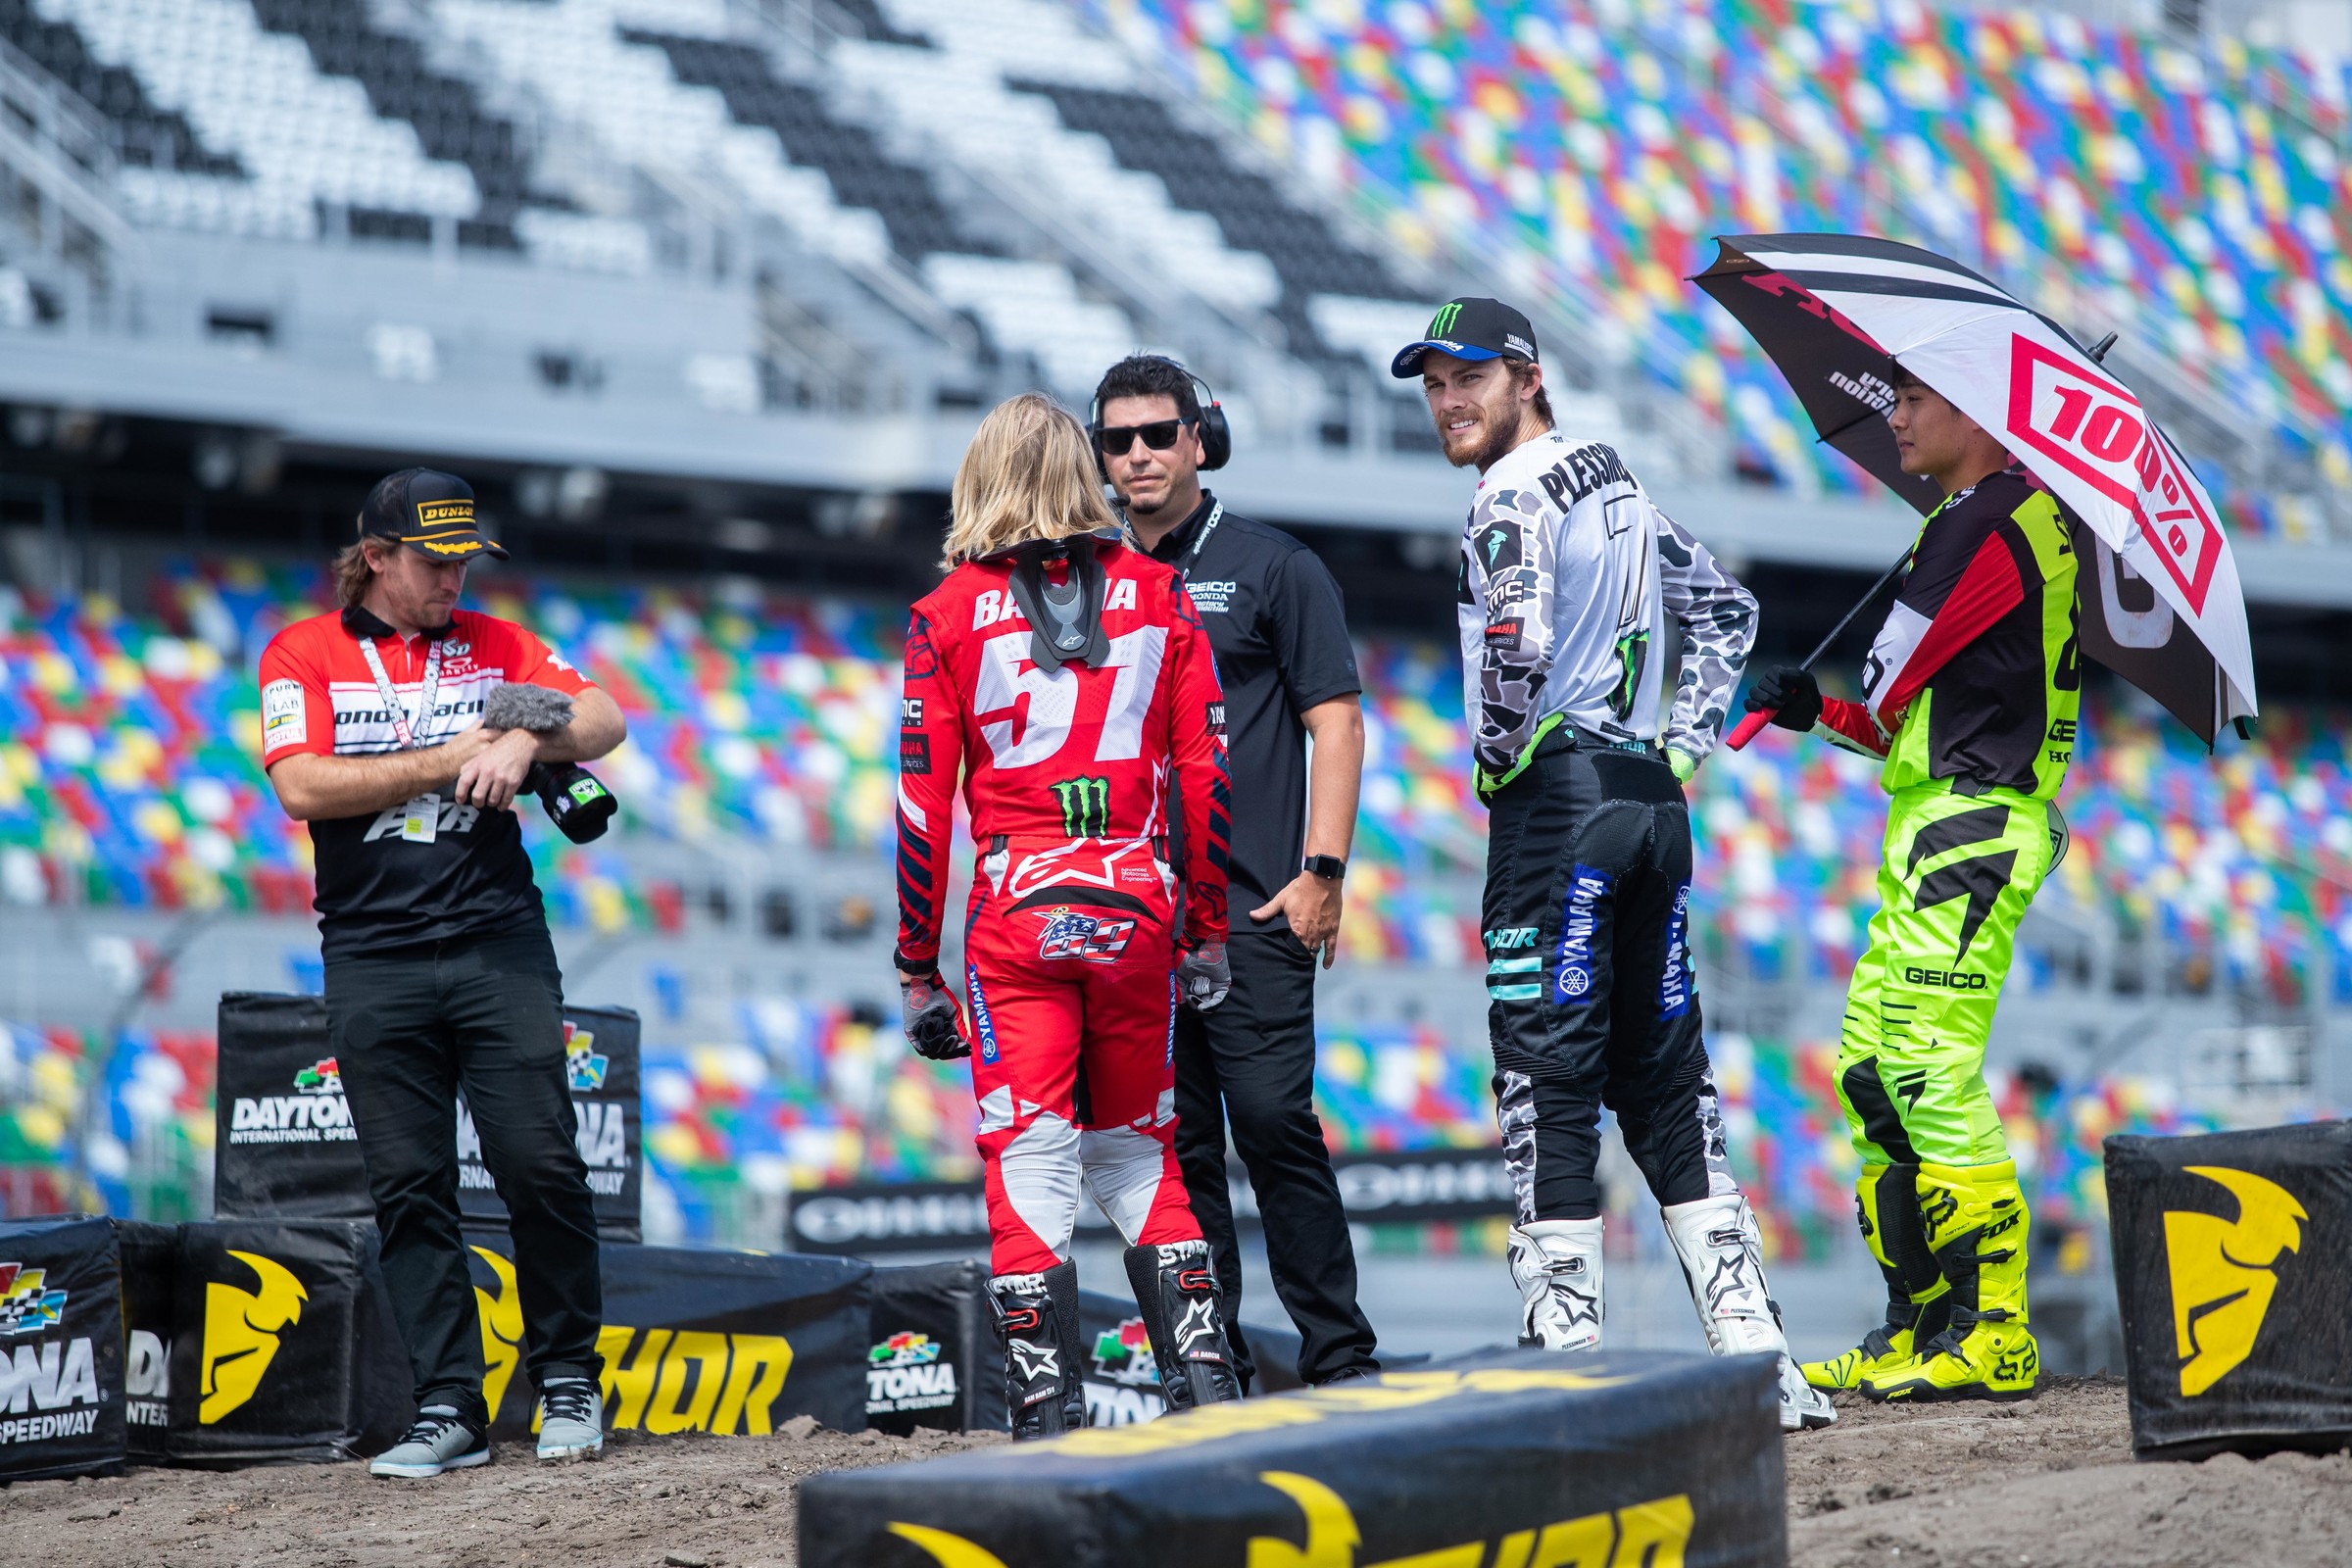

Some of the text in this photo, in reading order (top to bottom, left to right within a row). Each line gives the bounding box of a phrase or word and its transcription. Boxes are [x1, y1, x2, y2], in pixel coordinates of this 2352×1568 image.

[2049, 385, 2195, 557] 100%
[1184, 580, 1238, 594] GEICO
[1189, 592, 1229, 602] HONDA
[1561, 876, 1605, 966] YAMAHA
[1039, 916, 1138, 964] 69
[968, 970, 992, 1039] YAMAHA
[228, 1128, 321, 1145] INTERNATIONAL
[1978, 1208, 2022, 1241] FOX
[1886, 1386, 1915, 1400] FOX
